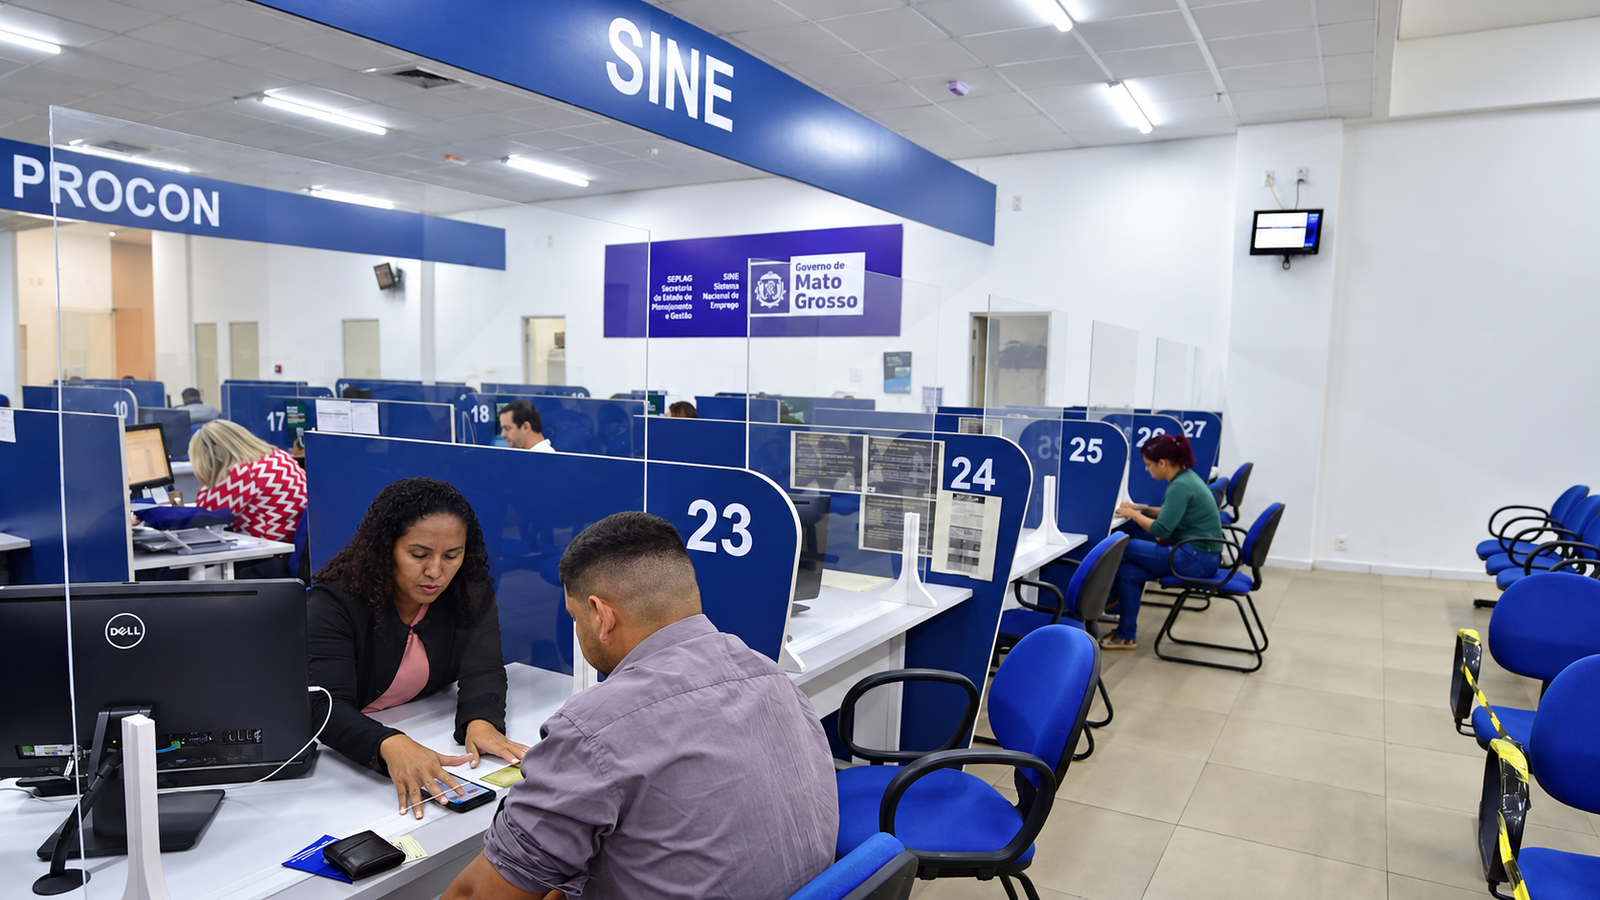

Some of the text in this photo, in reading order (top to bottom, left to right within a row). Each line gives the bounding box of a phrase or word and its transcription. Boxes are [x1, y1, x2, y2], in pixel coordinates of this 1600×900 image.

[606, 17, 734, 133] SINE
[13, 154, 220, 227] PROCON
[795, 260, 845, 272] Governo de
[667, 274, 693, 283] SEPLAG
[723, 272, 740, 281] SINE
[795, 273, 842, 290] Mato
[661, 284, 693, 292] Secretaria
[713, 282, 740, 290] Sistema
[702, 291, 740, 300] Nacional de
[795, 293, 858, 309] Grosso
[710, 301, 740, 310] Emprego
[113, 400, 128, 419] 10
[470, 404, 490, 423] 18
[266, 411, 286, 432] 17
[1183, 420, 1207, 438] 27
[1069, 436, 1103, 464] 25
[950, 456, 996, 492] 24
[686, 499, 753, 557] 23
[110, 626, 141, 636] DELL
